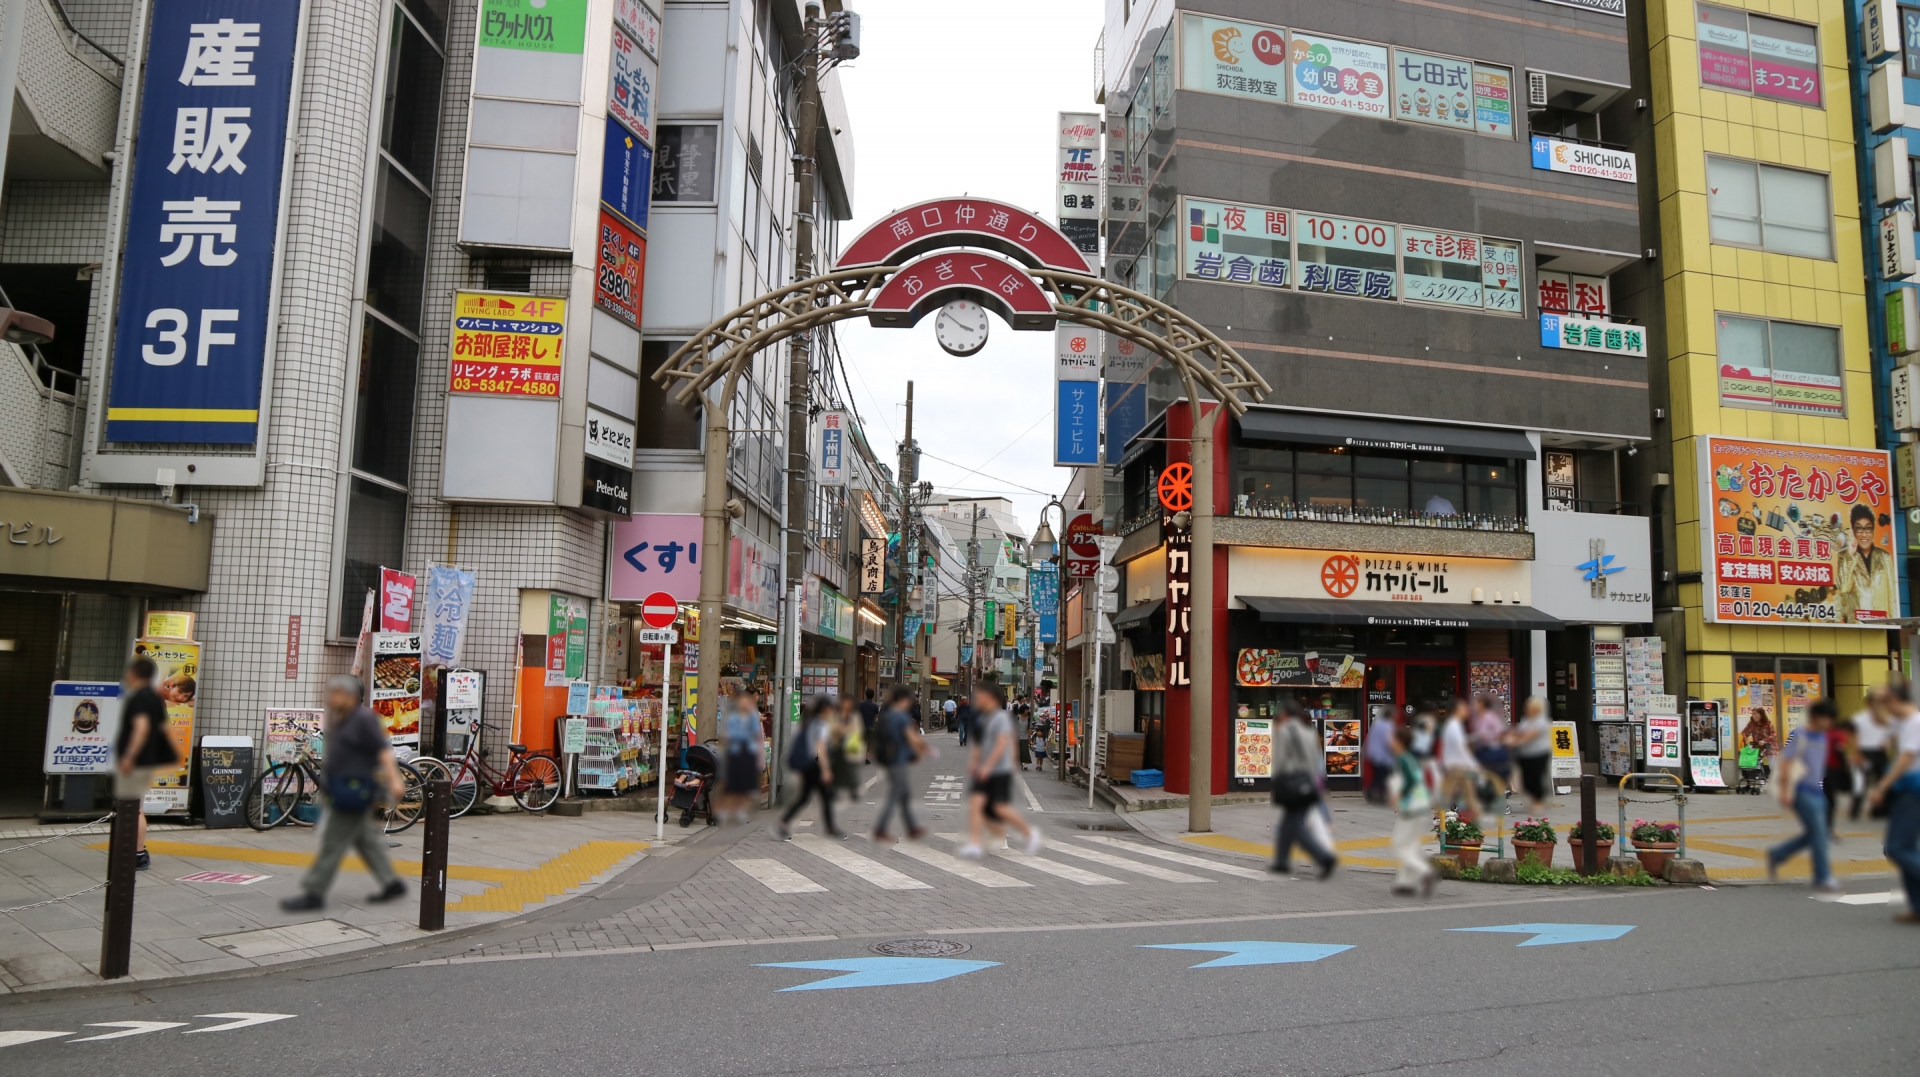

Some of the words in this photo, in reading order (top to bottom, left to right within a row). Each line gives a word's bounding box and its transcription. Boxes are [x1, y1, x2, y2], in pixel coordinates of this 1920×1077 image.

[484, 10, 554, 42] ピタットハウス
[1868, 4, 1881, 54] 竹西ビル
[483, 38, 512, 46] PITAT
[518, 41, 554, 50] HOUSE
[614, 30, 632, 53] 3F
[1257, 35, 1282, 57] 0歳
[1293, 48, 1327, 65] からの
[1331, 46, 1372, 60] 世界が認めた
[616, 51, 650, 94] にしざわ
[1216, 64, 1244, 74] SHICHIDA
[1352, 59, 1386, 71] 七田式教育
[1302, 67, 1379, 96] 幼児教室
[1399, 57, 1469, 91] 七田式
[1755, 68, 1815, 94] まつエク
[1217, 73, 1278, 97] 荻窪教室
[1475, 85, 1508, 99] 幼児コース
[614, 72, 649, 125] 歯科
[1308, 92, 1385, 114] 0120-41-5307
[1476, 98, 1508, 110] 英語コース
[1477, 110, 1509, 123] 小学生コース
[160, 19, 261, 267] 産販売
[1534, 141, 1549, 153] 4F
[642, 149, 650, 158] 3F
[1067, 149, 1092, 162] 7F
[1574, 150, 1632, 171] SHICHIDA
[1577, 165, 1633, 181] 0120-41-5307
[1064, 194, 1095, 209] 囲碁
[889, 204, 1038, 242] 南口仲通り
[1223, 207, 1288, 237] 夜間
[602, 224, 625, 252] ほぐし
[1308, 218, 1387, 248] 10:00
[628, 245, 639, 258] 4F
[1406, 234, 1477, 262] まで診療
[1484, 246, 1515, 262] 受付
[902, 259, 1024, 296] おぎくぼ
[1194, 252, 1392, 299] 岩倉歯科医院
[1483, 261, 1518, 278] 夜9時
[1538, 279, 1606, 319] 歯科
[463, 306, 491, 316] LIVING
[493, 308, 515, 317] LABO
[521, 301, 556, 317] 4F
[459, 319, 561, 333] アパート・マンション
[1543, 317, 1558, 331] 3F
[142, 308, 240, 367] 3F
[1564, 322, 1644, 352] 岩倉歯科
[454, 333, 562, 360] お部屋探し！
[1061, 358, 1096, 367] カヤバール
[454, 364, 531, 380] リビング・ラボ
[534, 372, 560, 382] 荻窪店
[453, 378, 556, 395] 03-5347-4580
[1730, 383, 1771, 394] OGIKUBO
[1773, 388, 1802, 398] MUSIC
[1804, 391, 1841, 402] SCHOOL
[825, 415, 839, 428] 質
[1071, 388, 1085, 455] サカエビル
[602, 426, 631, 449] どにどに
[1390, 441, 1417, 450] カヤバール
[825, 430, 839, 468] 上州屋
[1560, 455, 1572, 465] 2階
[1554, 473, 1572, 483] 24席
[1747, 459, 1887, 506] おたからや
[596, 479, 613, 496] Peter
[614, 486, 628, 500] Cole
[0, 520, 64, 545] ビル
[1072, 532, 1097, 545] ガス
[1717, 533, 1832, 560] 高価現金買取
[1070, 561, 1090, 575] 2F
[1365, 558, 1401, 570] PIZZA
[1406, 561, 1413, 572] &
[1418, 562, 1448, 573] WINE
[1720, 561, 1773, 580] 査定無料
[1780, 565, 1831, 582] 安心対応
[1366, 571, 1449, 594] カヤバール
[1609, 591, 1651, 602] サカエビル
[1719, 585, 1752, 598] 荻窪店
[1168, 549, 1191, 687] カヤバール
[1733, 601, 1836, 619] 0120-444-784
[429, 586, 464, 661] 冷麺
[1413, 618, 1441, 626] カヤバール
[379, 640, 406, 648] どにどに
[642, 632, 675, 641] 自転車を除く
[288, 657, 297, 665] 30
[1265, 655, 1299, 669] Pizza
[1320, 658, 1339, 668] Glass
[184, 666, 195, 674] B1
[1318, 665, 1338, 676] Wine
[1556, 730, 1571, 750] 碁
[202, 748, 221, 758] Peter
[206, 775, 235, 785] OPEN
[217, 785, 243, 793] 16:00
